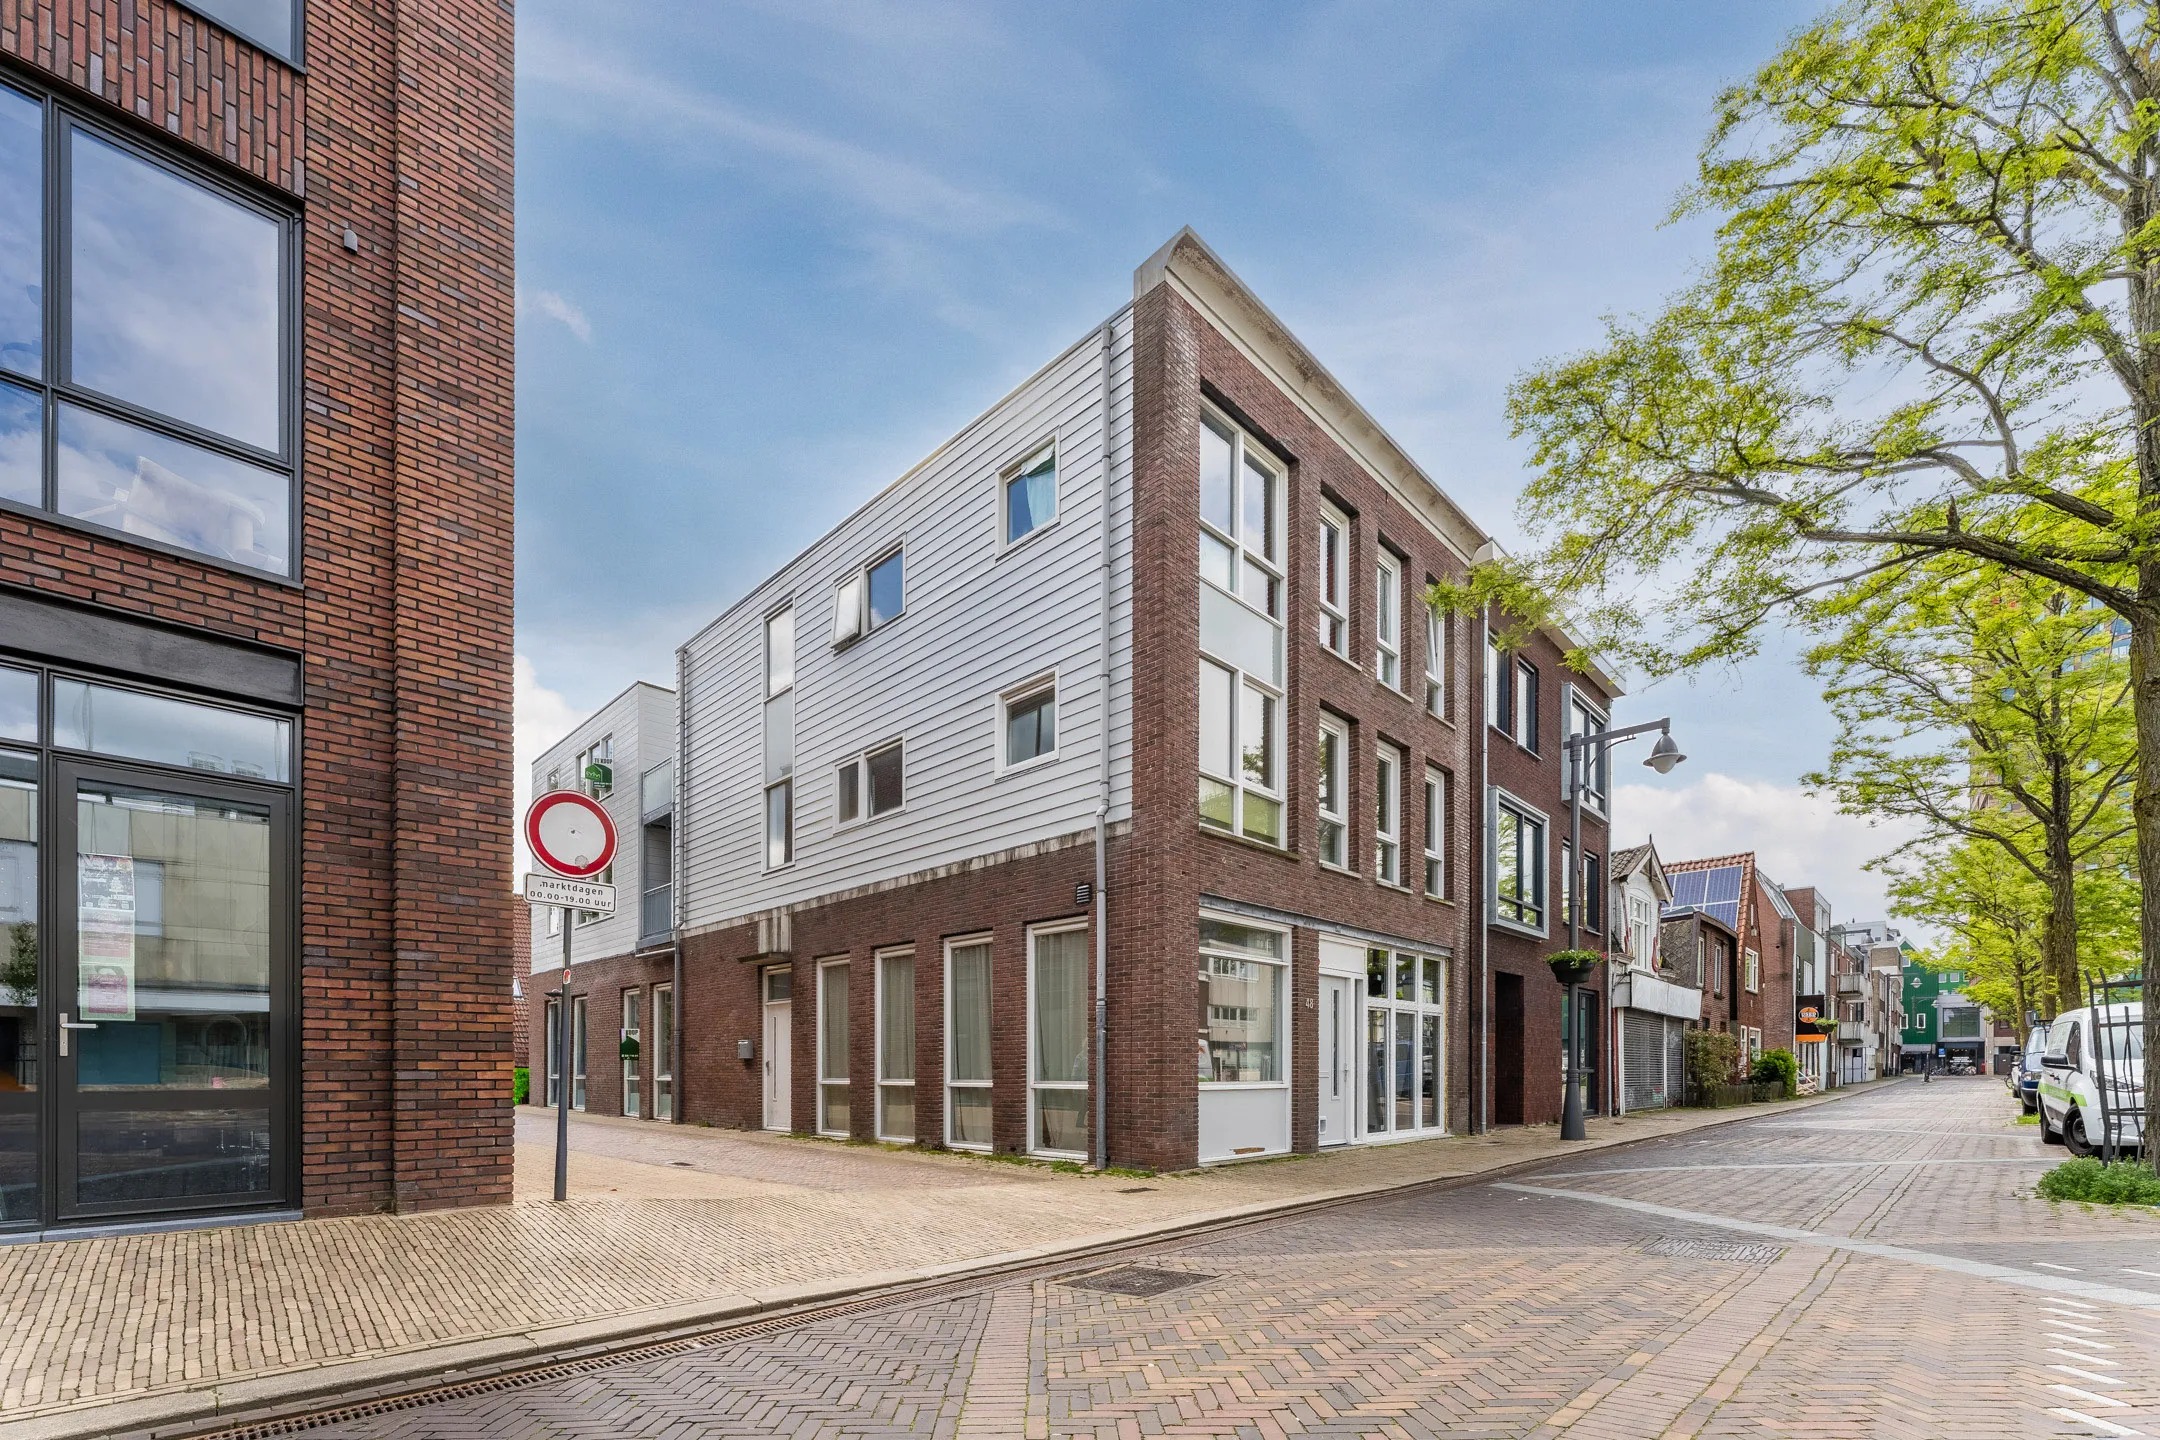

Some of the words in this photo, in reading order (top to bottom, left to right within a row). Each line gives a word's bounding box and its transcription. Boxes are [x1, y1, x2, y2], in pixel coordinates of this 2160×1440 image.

[530, 890, 591, 905] 00.00-19.00
[594, 899, 612, 908] uur
[1305, 997, 1314, 1009] 48
